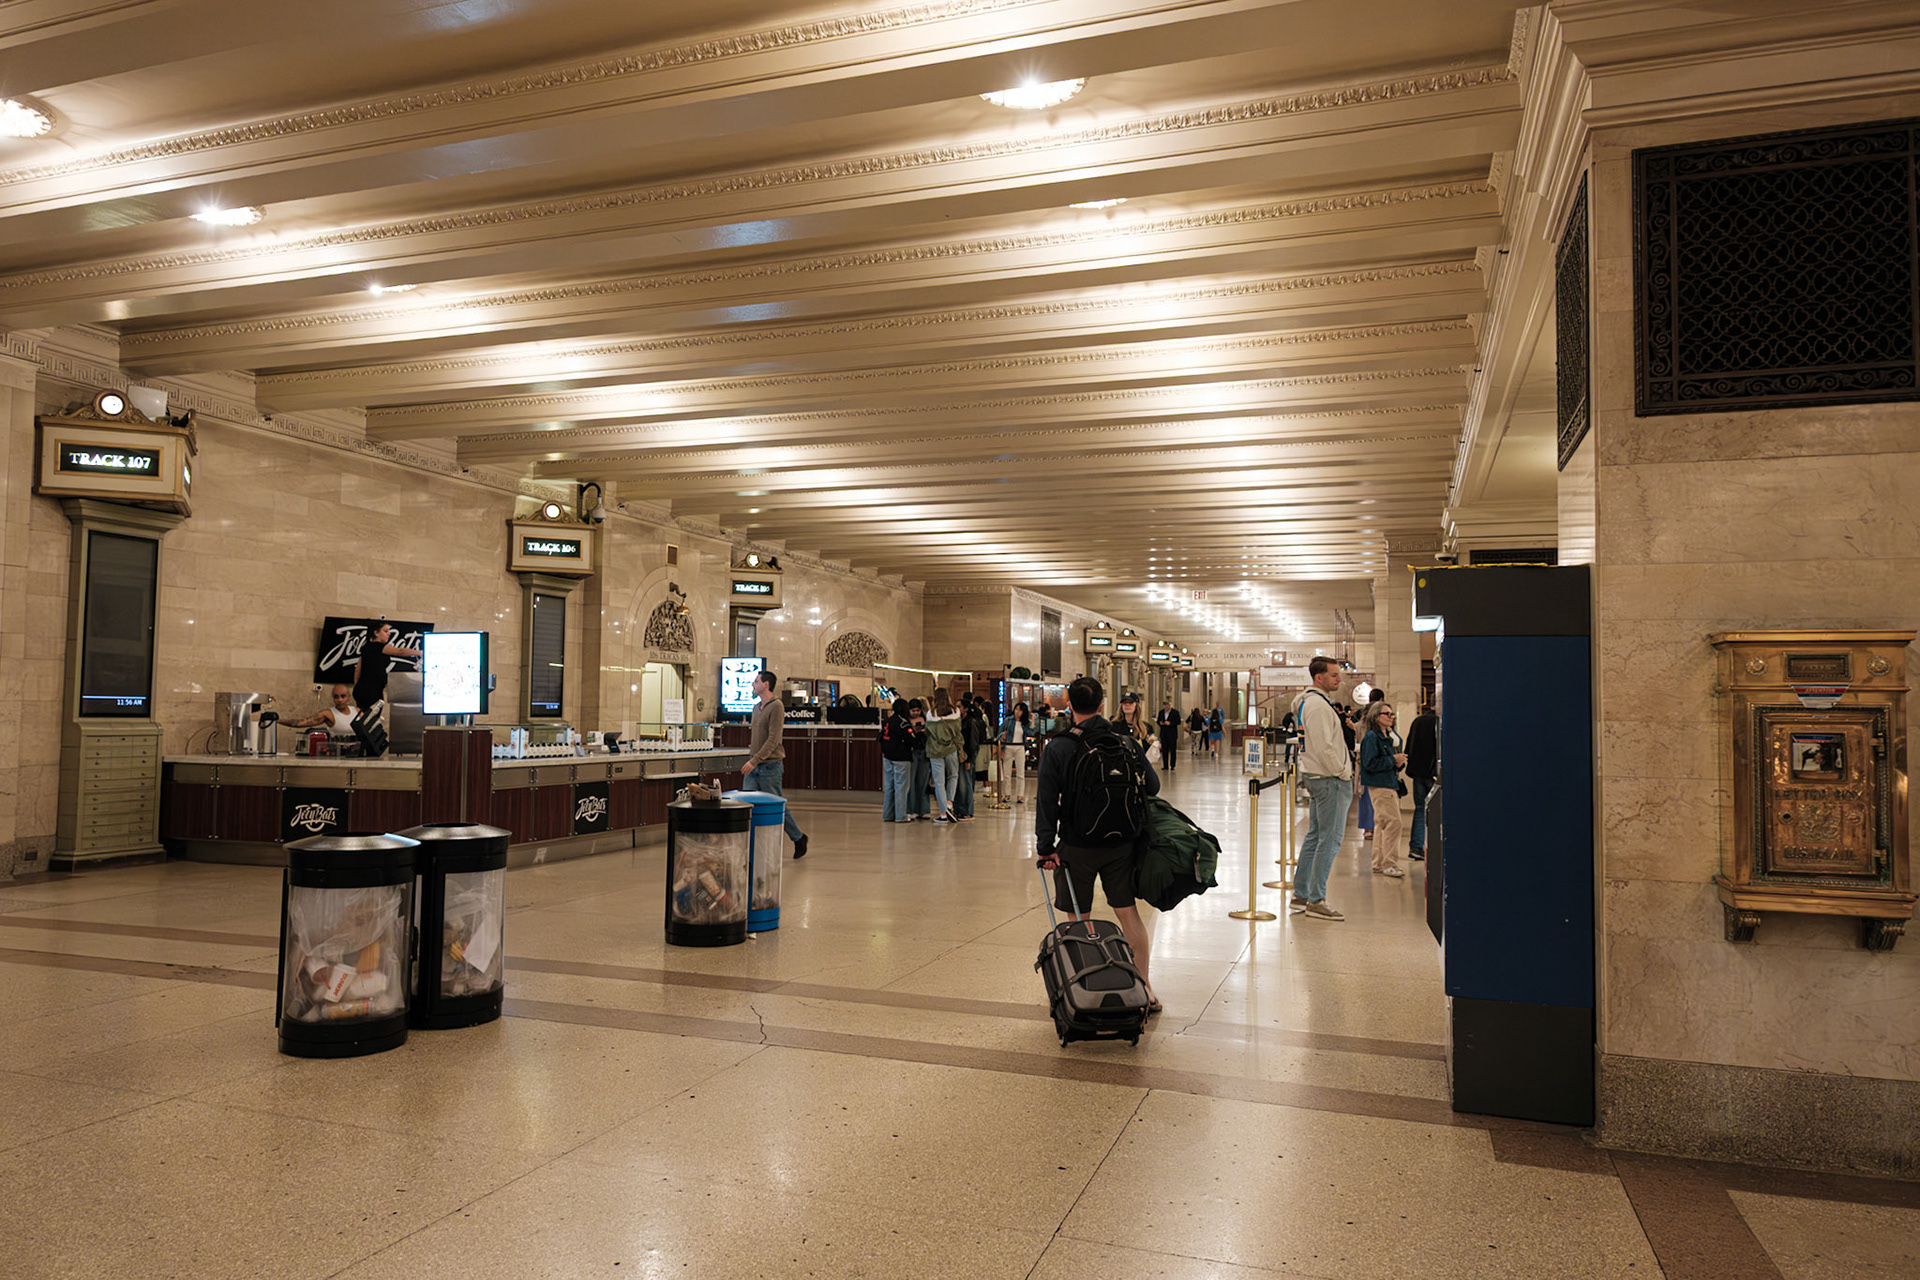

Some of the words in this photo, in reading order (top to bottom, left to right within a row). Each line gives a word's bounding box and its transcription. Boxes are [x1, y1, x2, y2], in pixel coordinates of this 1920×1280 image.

[69, 452, 125, 467] TRACK
[127, 456, 151, 469] 107
[527, 541, 560, 552] TRACK
[561, 544, 576, 553] 106
[735, 584, 759, 592] TRACK
[1194, 590, 1206, 600] EXIT
[784, 710, 815, 718] oeCoffee
[1248, 743, 1259, 753] TAKE
[1774, 788, 1828, 801] LETTER
[1834, 788, 1863, 801] BOX
